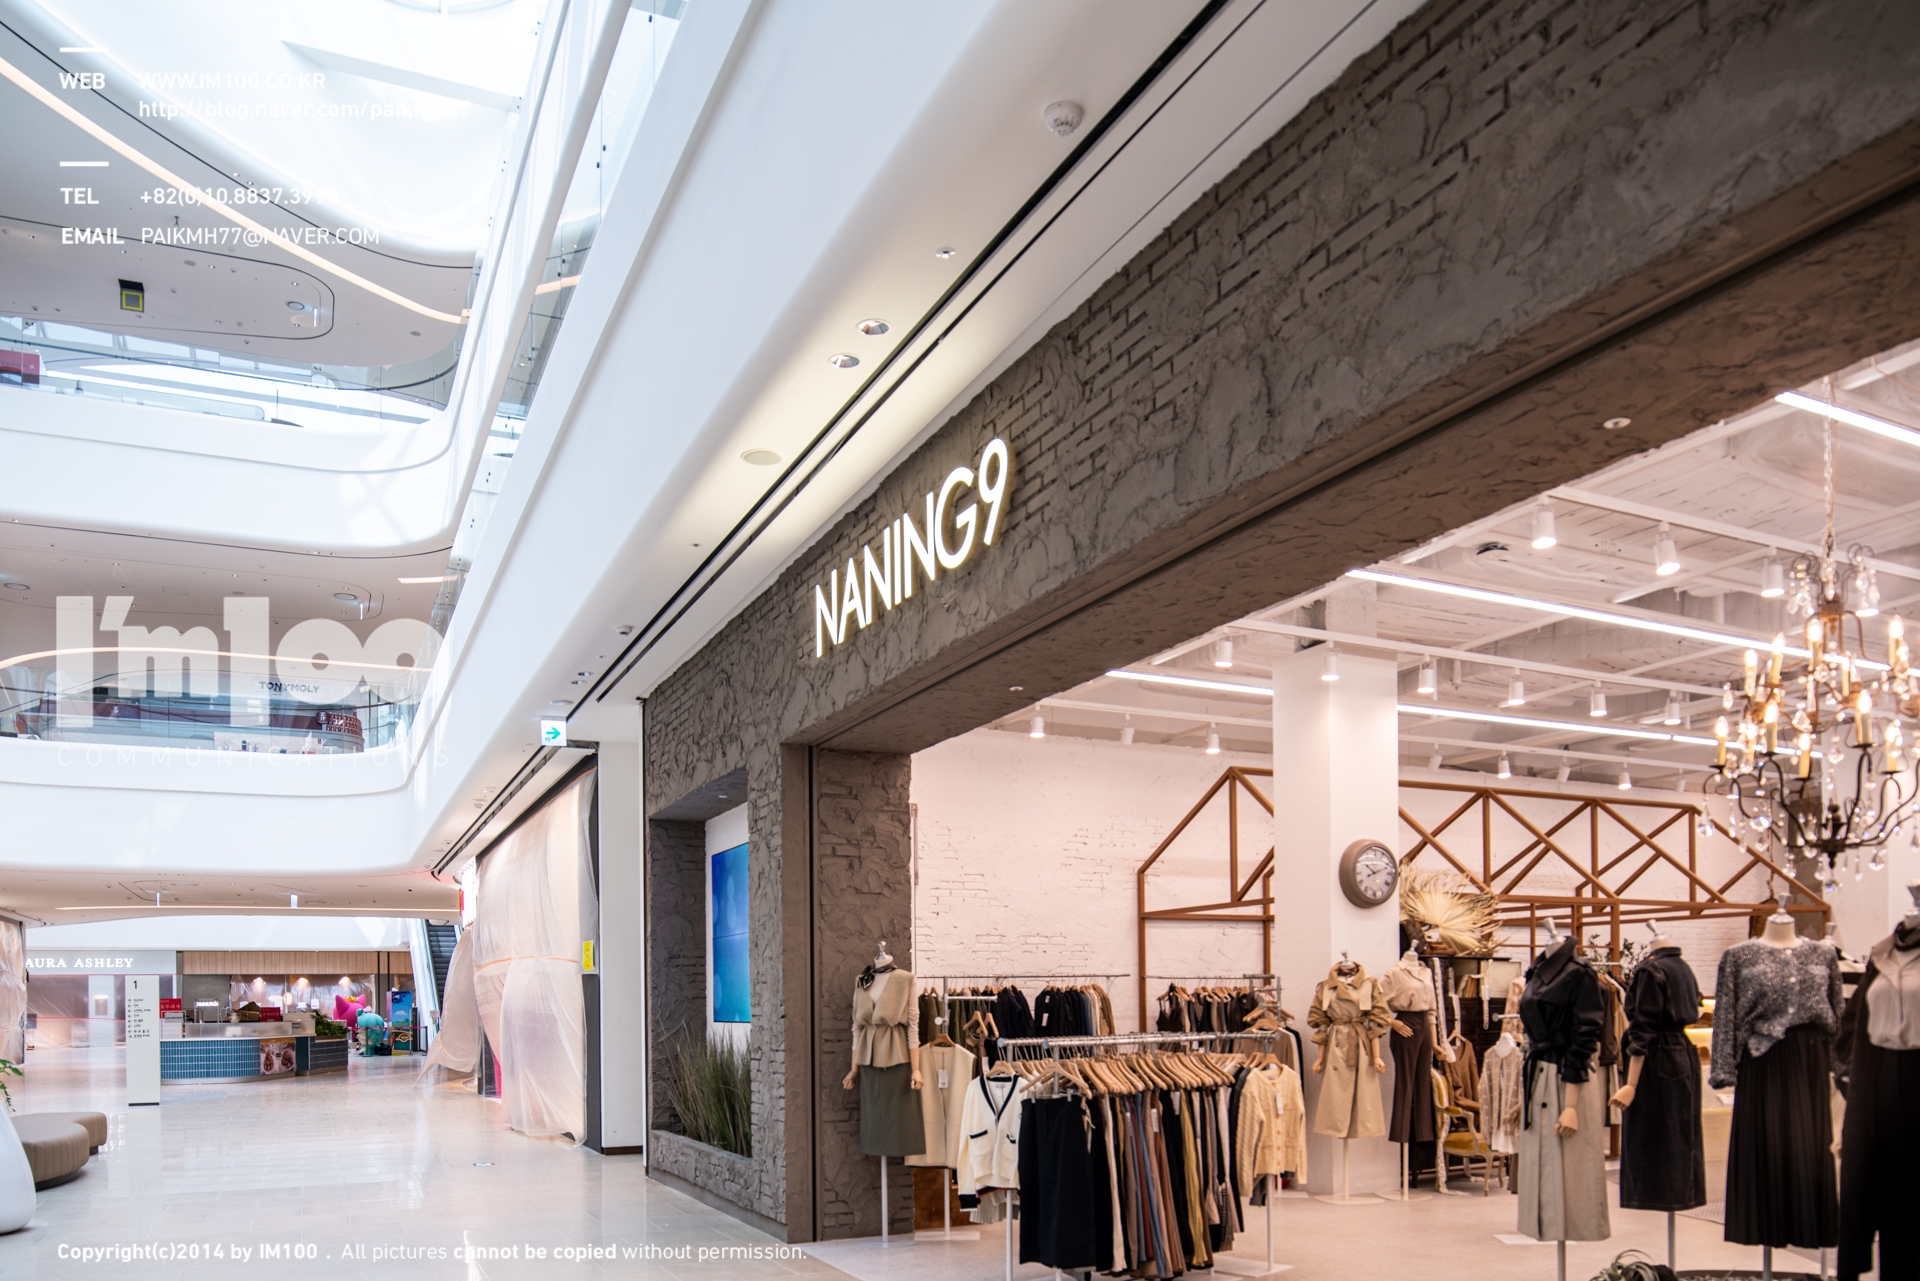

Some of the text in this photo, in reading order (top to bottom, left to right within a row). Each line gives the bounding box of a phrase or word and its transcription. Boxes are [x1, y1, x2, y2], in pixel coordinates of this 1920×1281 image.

[815, 437, 1009, 658] NANING9
[259, 681, 321, 694] TONYMOLY
[25, 957, 134, 968] AURA ASHLEY
[133, 980, 138, 990] 1
